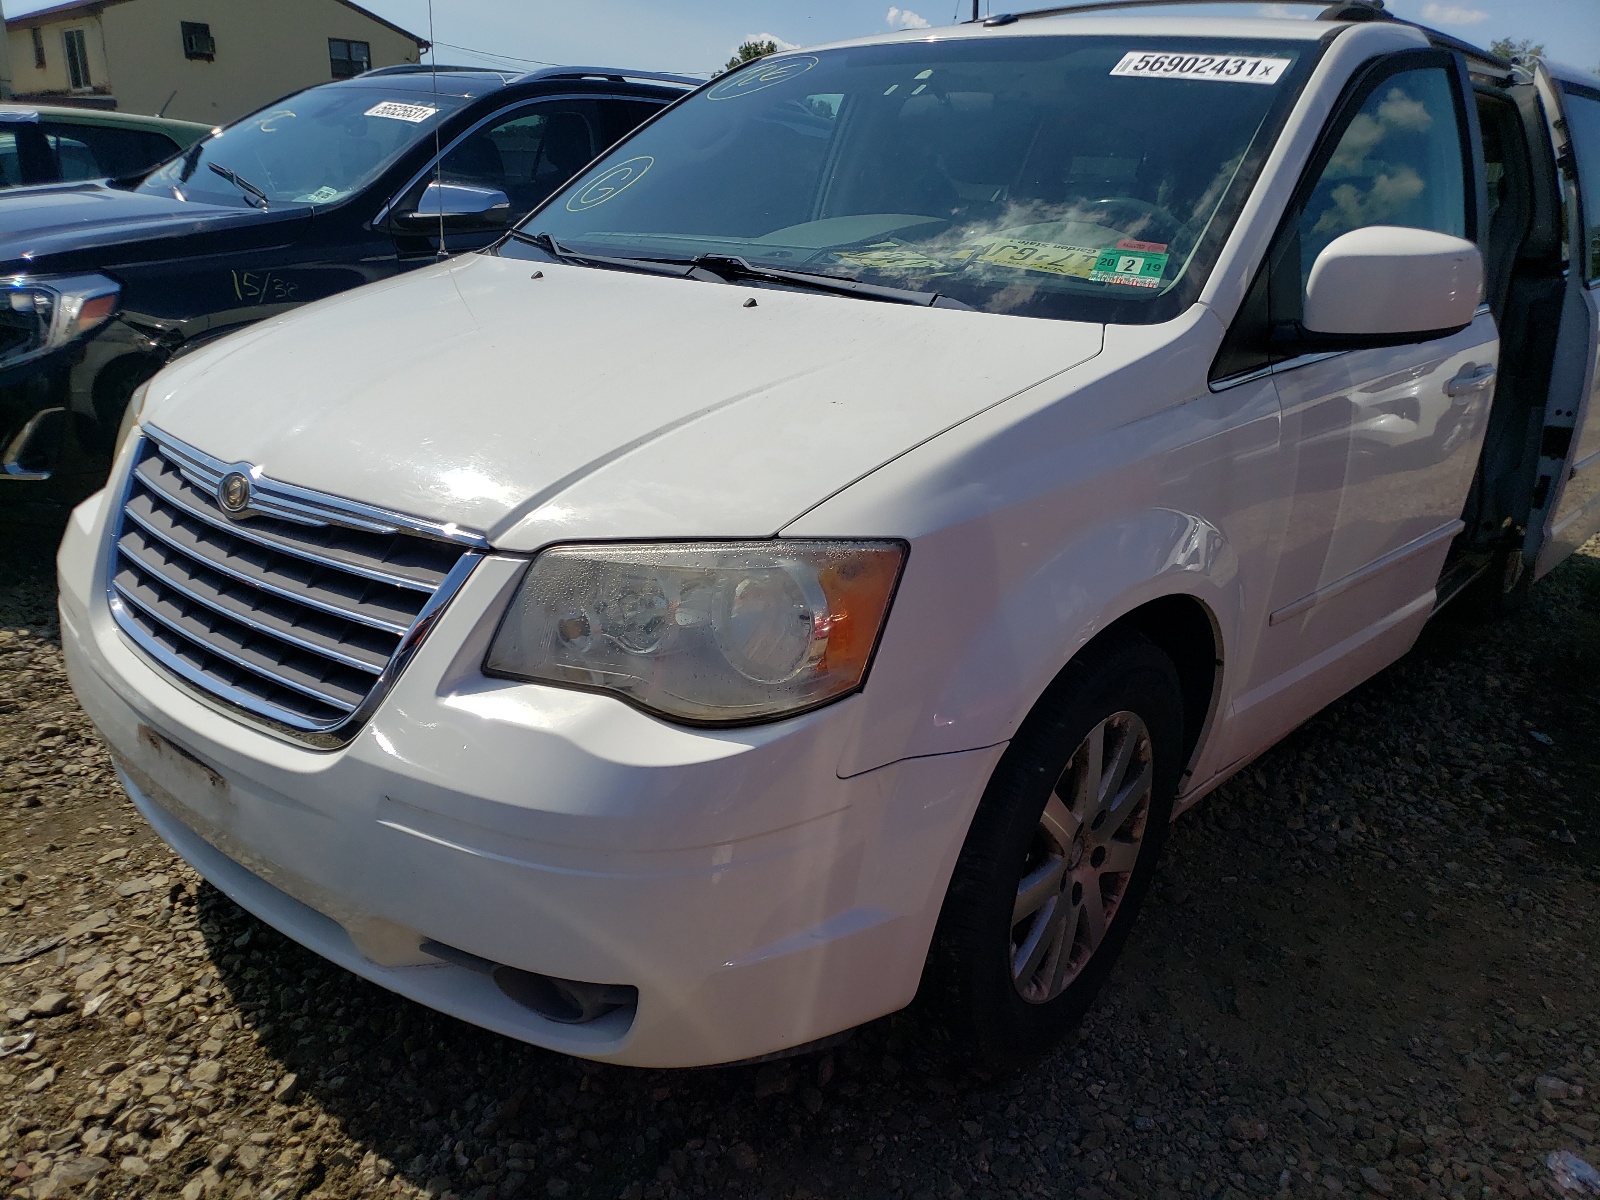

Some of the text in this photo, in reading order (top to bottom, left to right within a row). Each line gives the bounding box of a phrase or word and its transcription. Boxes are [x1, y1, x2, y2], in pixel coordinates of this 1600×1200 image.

[1098, 257, 1162, 272] 20 2 19
